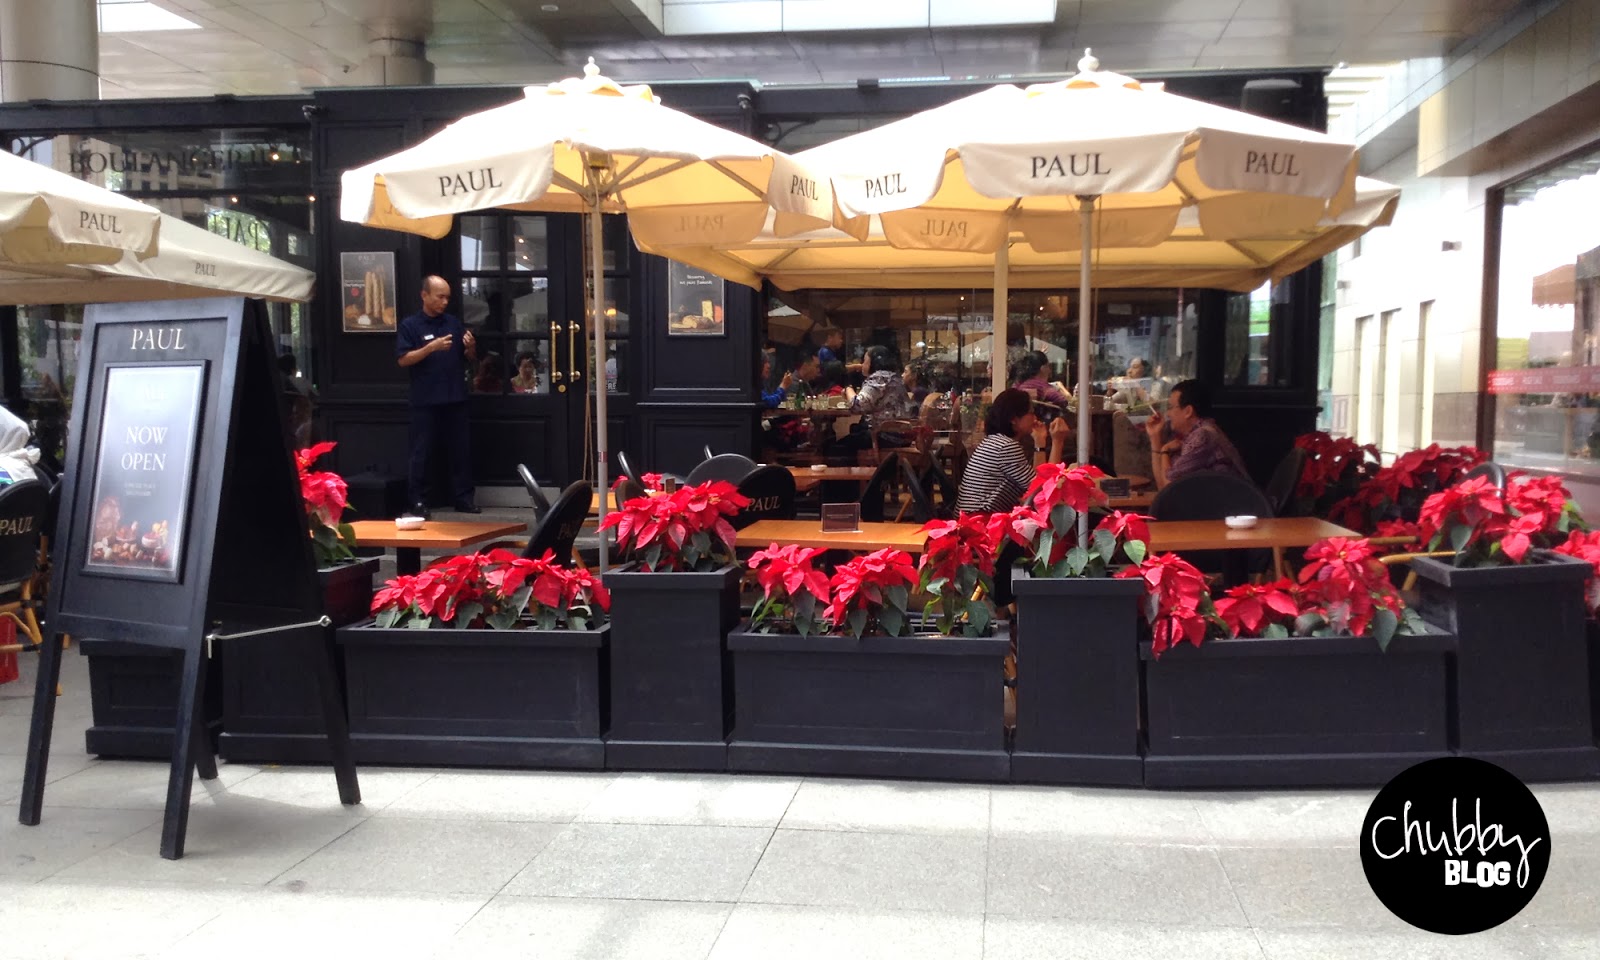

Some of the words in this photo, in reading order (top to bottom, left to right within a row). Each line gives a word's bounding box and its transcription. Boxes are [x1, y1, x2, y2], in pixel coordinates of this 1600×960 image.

[1031, 152, 1112, 178] PAUL
[1245, 150, 1300, 176] PAUL
[438, 168, 503, 197] PAUL
[790, 174, 819, 201] PAUL
[865, 173, 907, 199] PAUL
[79, 211, 122, 234] PAUL
[195, 262, 217, 277] PAUL
[131, 328, 187, 350] PAUL
[126, 426, 168, 444] NOW
[121, 452, 167, 471] OPEN
[745, 496, 780, 512] PAUL
[0, 516, 33, 535] PAUL
